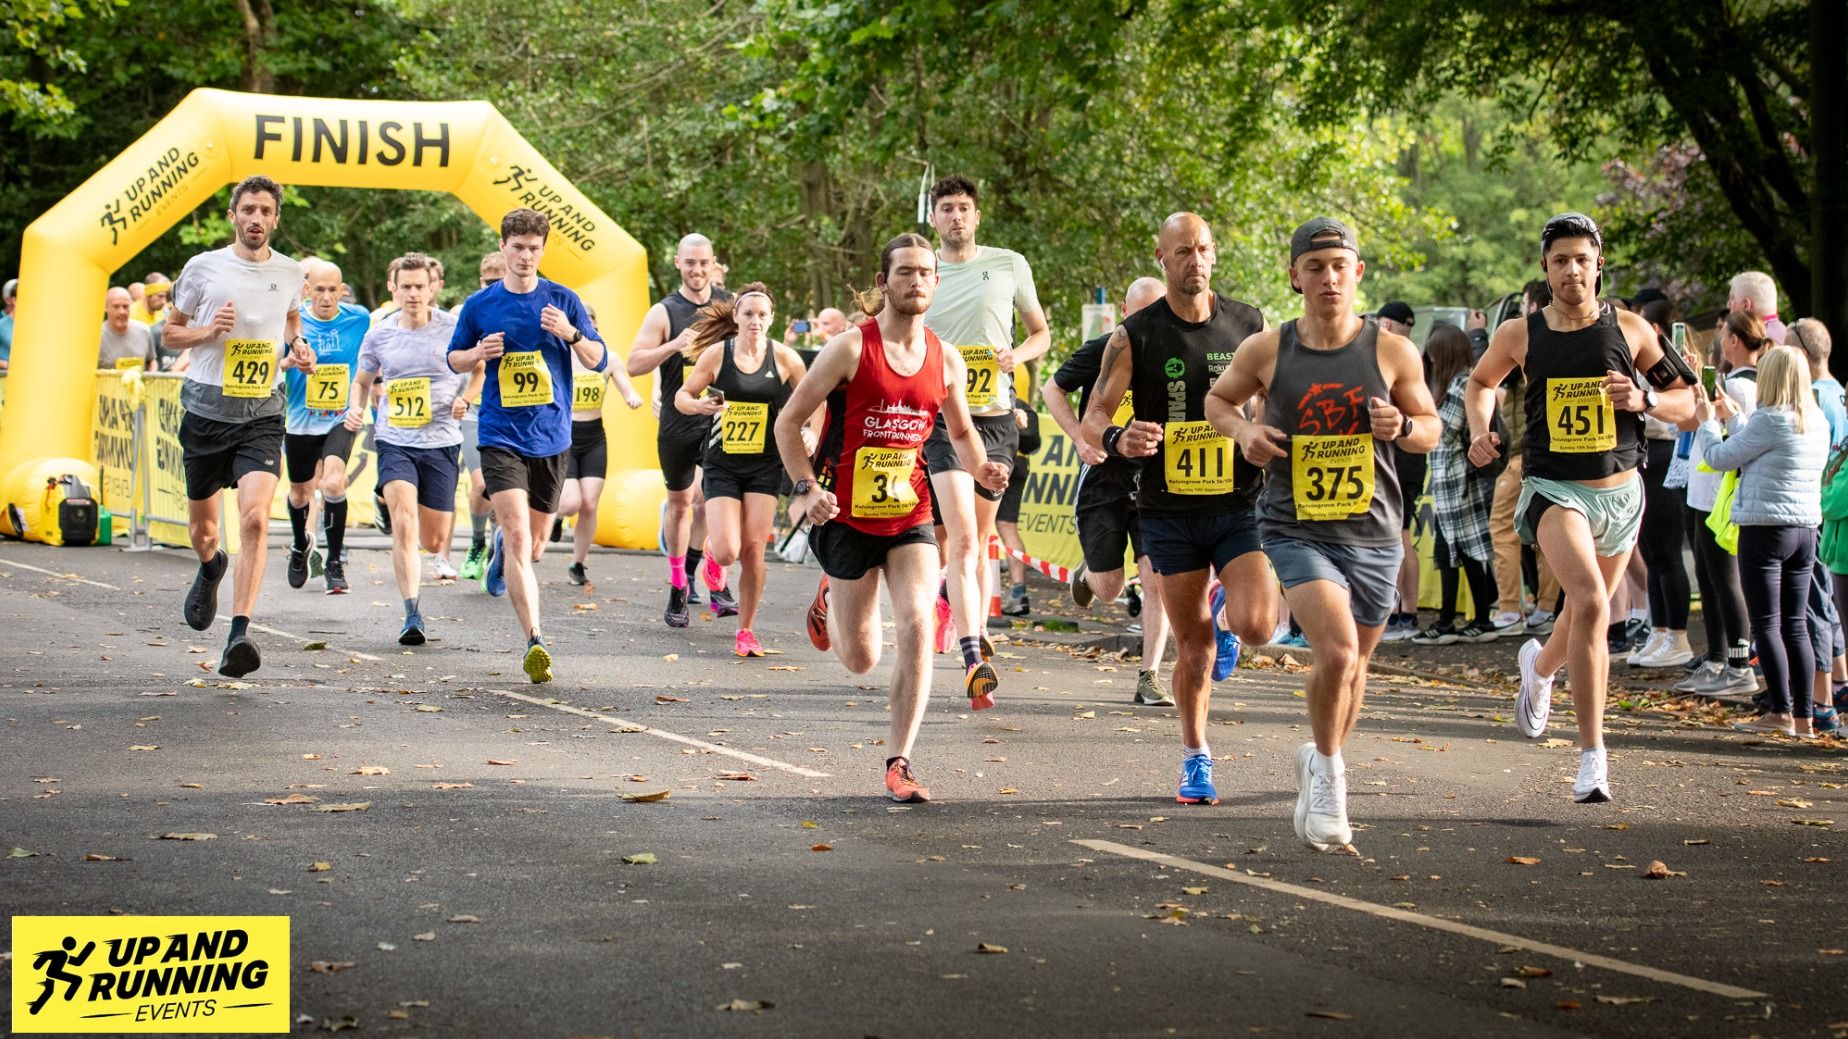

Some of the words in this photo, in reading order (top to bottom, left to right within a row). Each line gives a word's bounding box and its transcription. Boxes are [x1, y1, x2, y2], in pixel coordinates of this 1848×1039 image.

[254, 114, 450, 168] FINISH
[124, 177, 146, 201] UP
[148, 147, 180, 183] AND
[130, 152, 199, 222] RUNNING
[539, 185, 562, 203] UP
[559, 204, 596, 232] AND
[519, 192, 595, 251] RUNNING
[232, 360, 269, 384] 429
[514, 371, 538, 393] 99
[967, 368, 992, 393] 92
[319, 382, 338, 399] 75
[576, 387, 600, 402] 198
[1167, 381, 1186, 422] SPAR
[1567, 388, 1602, 398] RUNNIN
[395, 397, 424, 416] 512
[726, 421, 760, 441] 227
[864, 416, 927, 431] GLASGOW
[1191, 426, 1203, 434] UP
[1558, 405, 1604, 435] 451
[1187, 431, 1222, 442] RUNNIN
[1322, 441, 1336, 449] UP
[1337, 438, 1360, 448] AND
[1177, 447, 1223, 477] 411
[1317, 445, 1366, 459] RUNNING
[1306, 465, 1364, 501] 375
